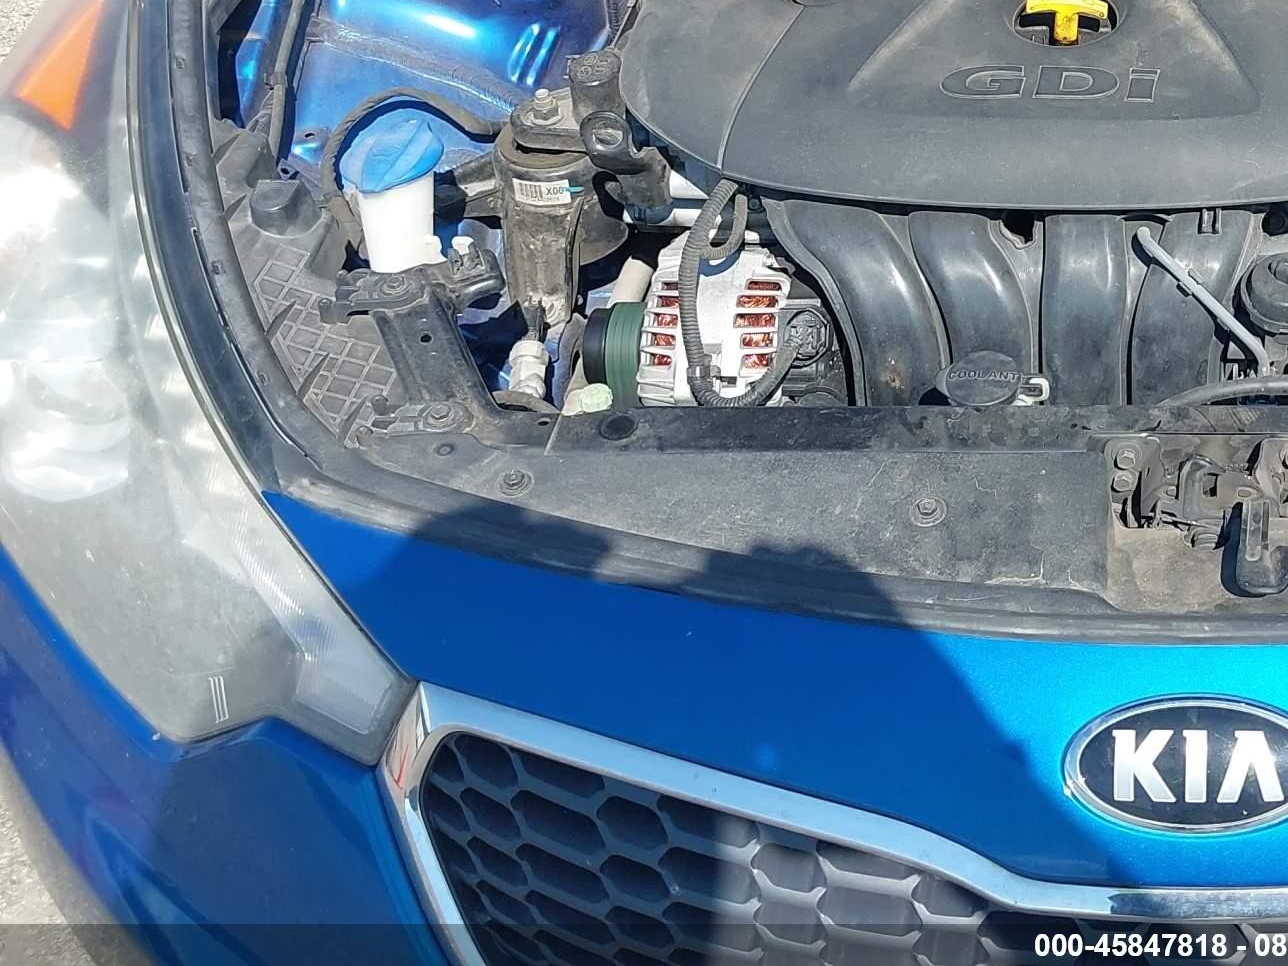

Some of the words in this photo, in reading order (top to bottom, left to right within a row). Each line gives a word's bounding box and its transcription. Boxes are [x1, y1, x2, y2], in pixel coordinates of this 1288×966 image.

[939, 65, 1161, 102] GDi
[948, 370, 1020, 382] COOLANT
[1112, 729, 1285, 803] KIA
